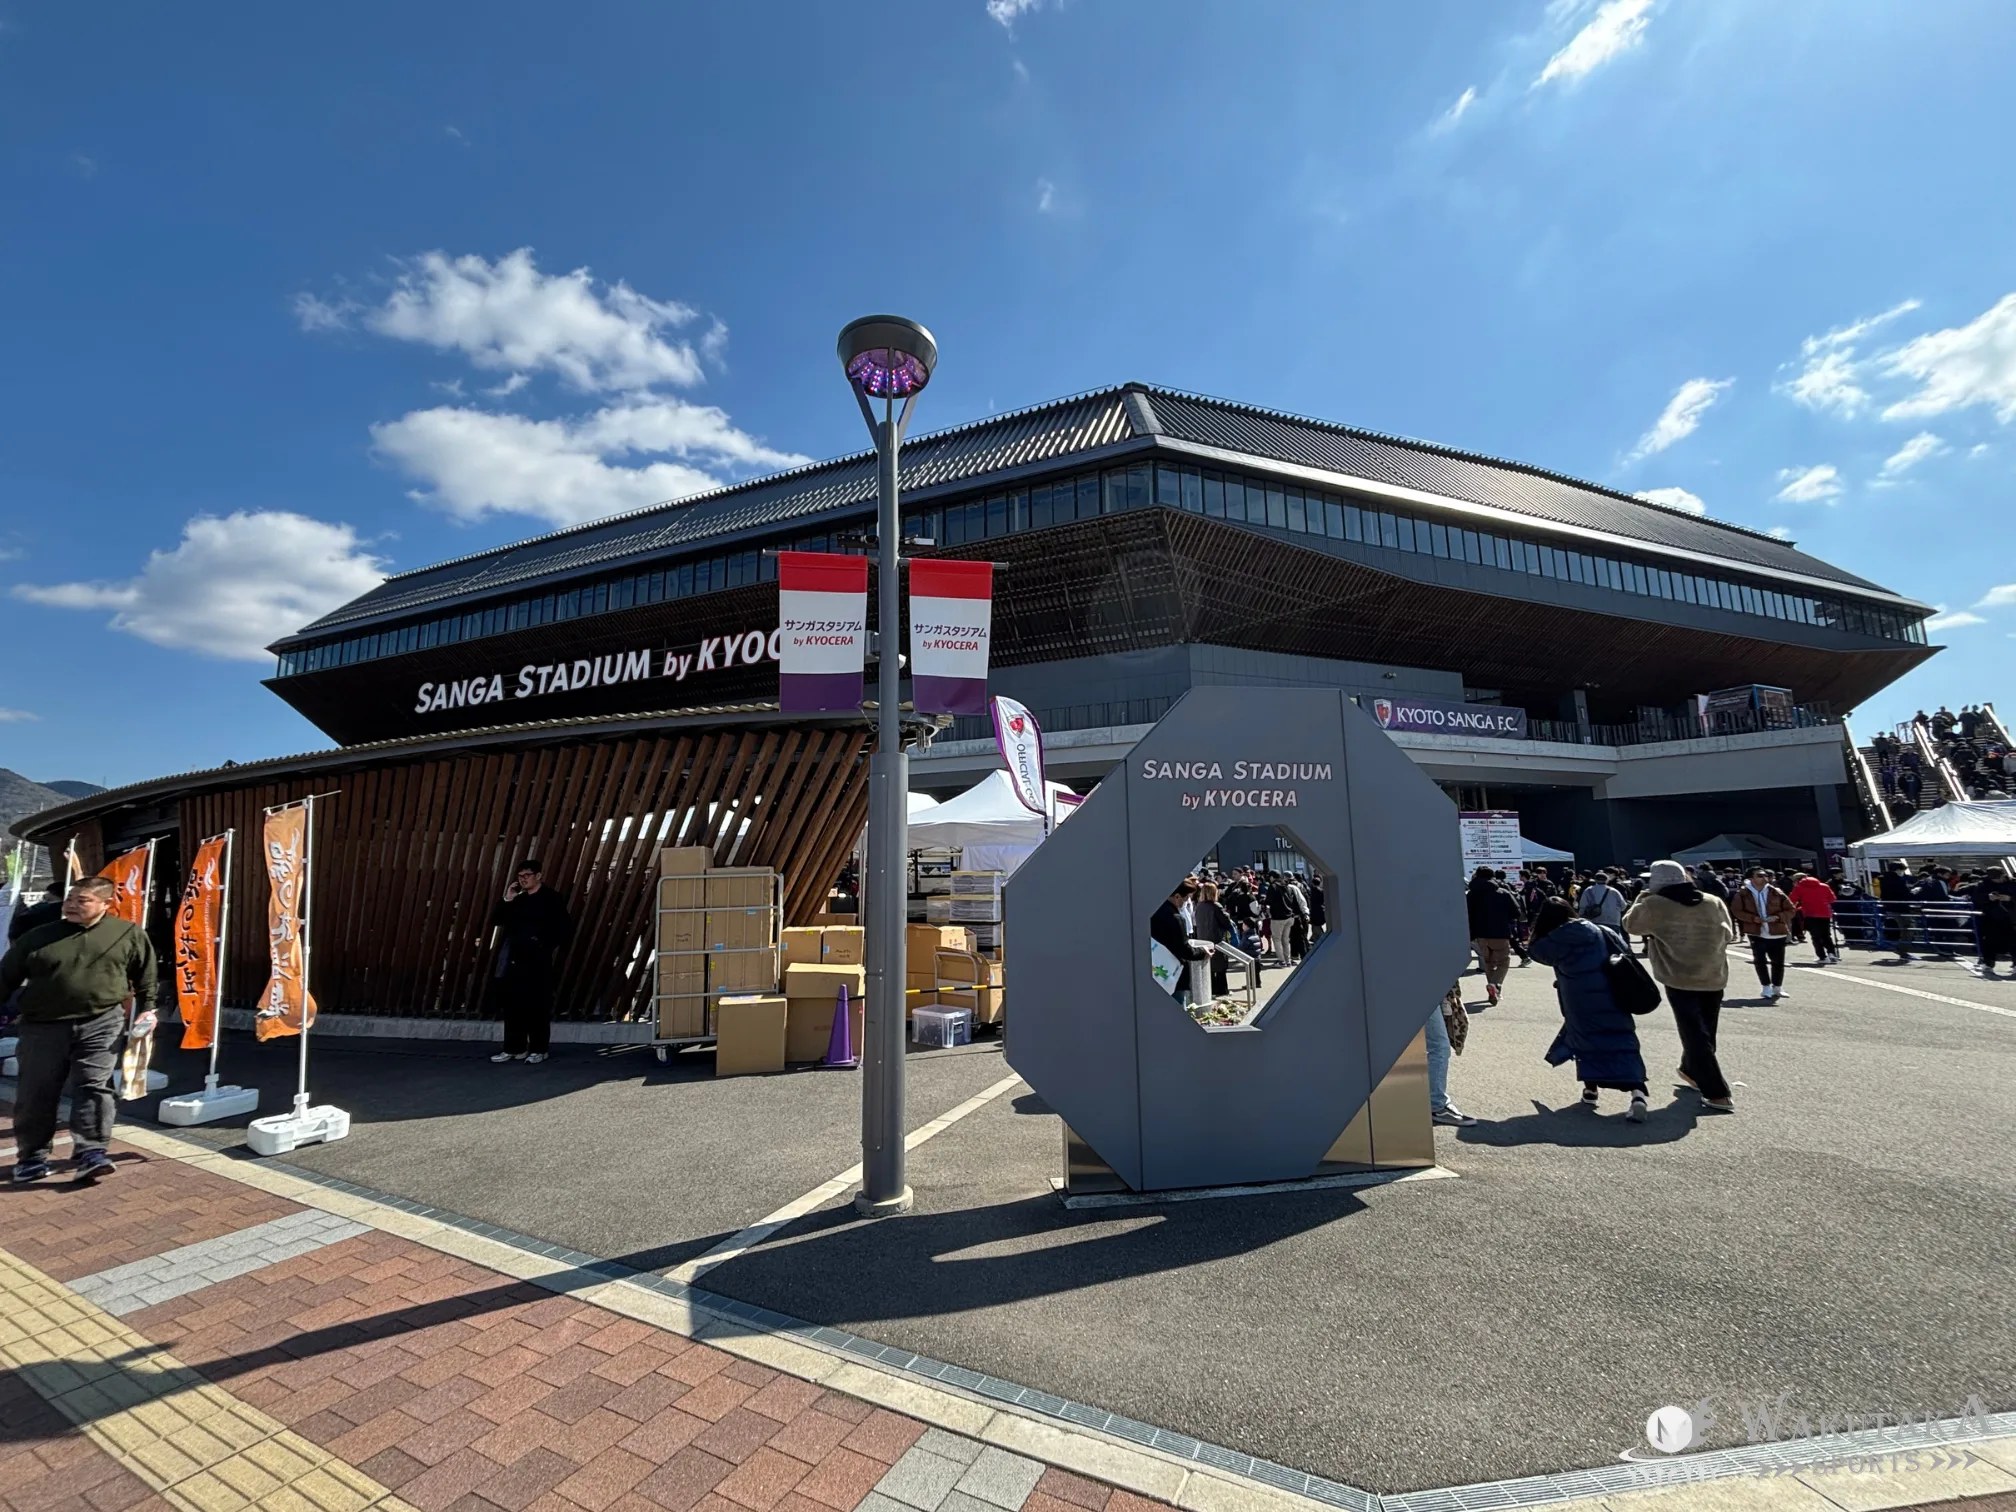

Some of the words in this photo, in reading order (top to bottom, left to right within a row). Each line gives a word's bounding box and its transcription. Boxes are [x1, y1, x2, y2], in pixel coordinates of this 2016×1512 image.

[784, 620, 862, 632] サンガスタジアム
[914, 624, 987, 638] サンガスタジアム
[793, 637, 804, 647] by
[806, 636, 854, 646] KYOCERA
[922, 640, 932, 650] by
[933, 639, 979, 651] KYOCERA
[414, 674, 504, 714] SANGA
[514, 649, 651, 698] STADIUM
[662, 651, 693, 681] by
[1396, 707, 1445, 726] KYOTO
[1447, 711, 1496, 730] SANGA
[1497, 716, 1518, 732] F.C.
[1142, 759, 1223, 780] SANGA
[1233, 760, 1332, 781] STADIUM
[1182, 793, 1200, 810] by
[1204, 789, 1298, 808] KYOCERA
